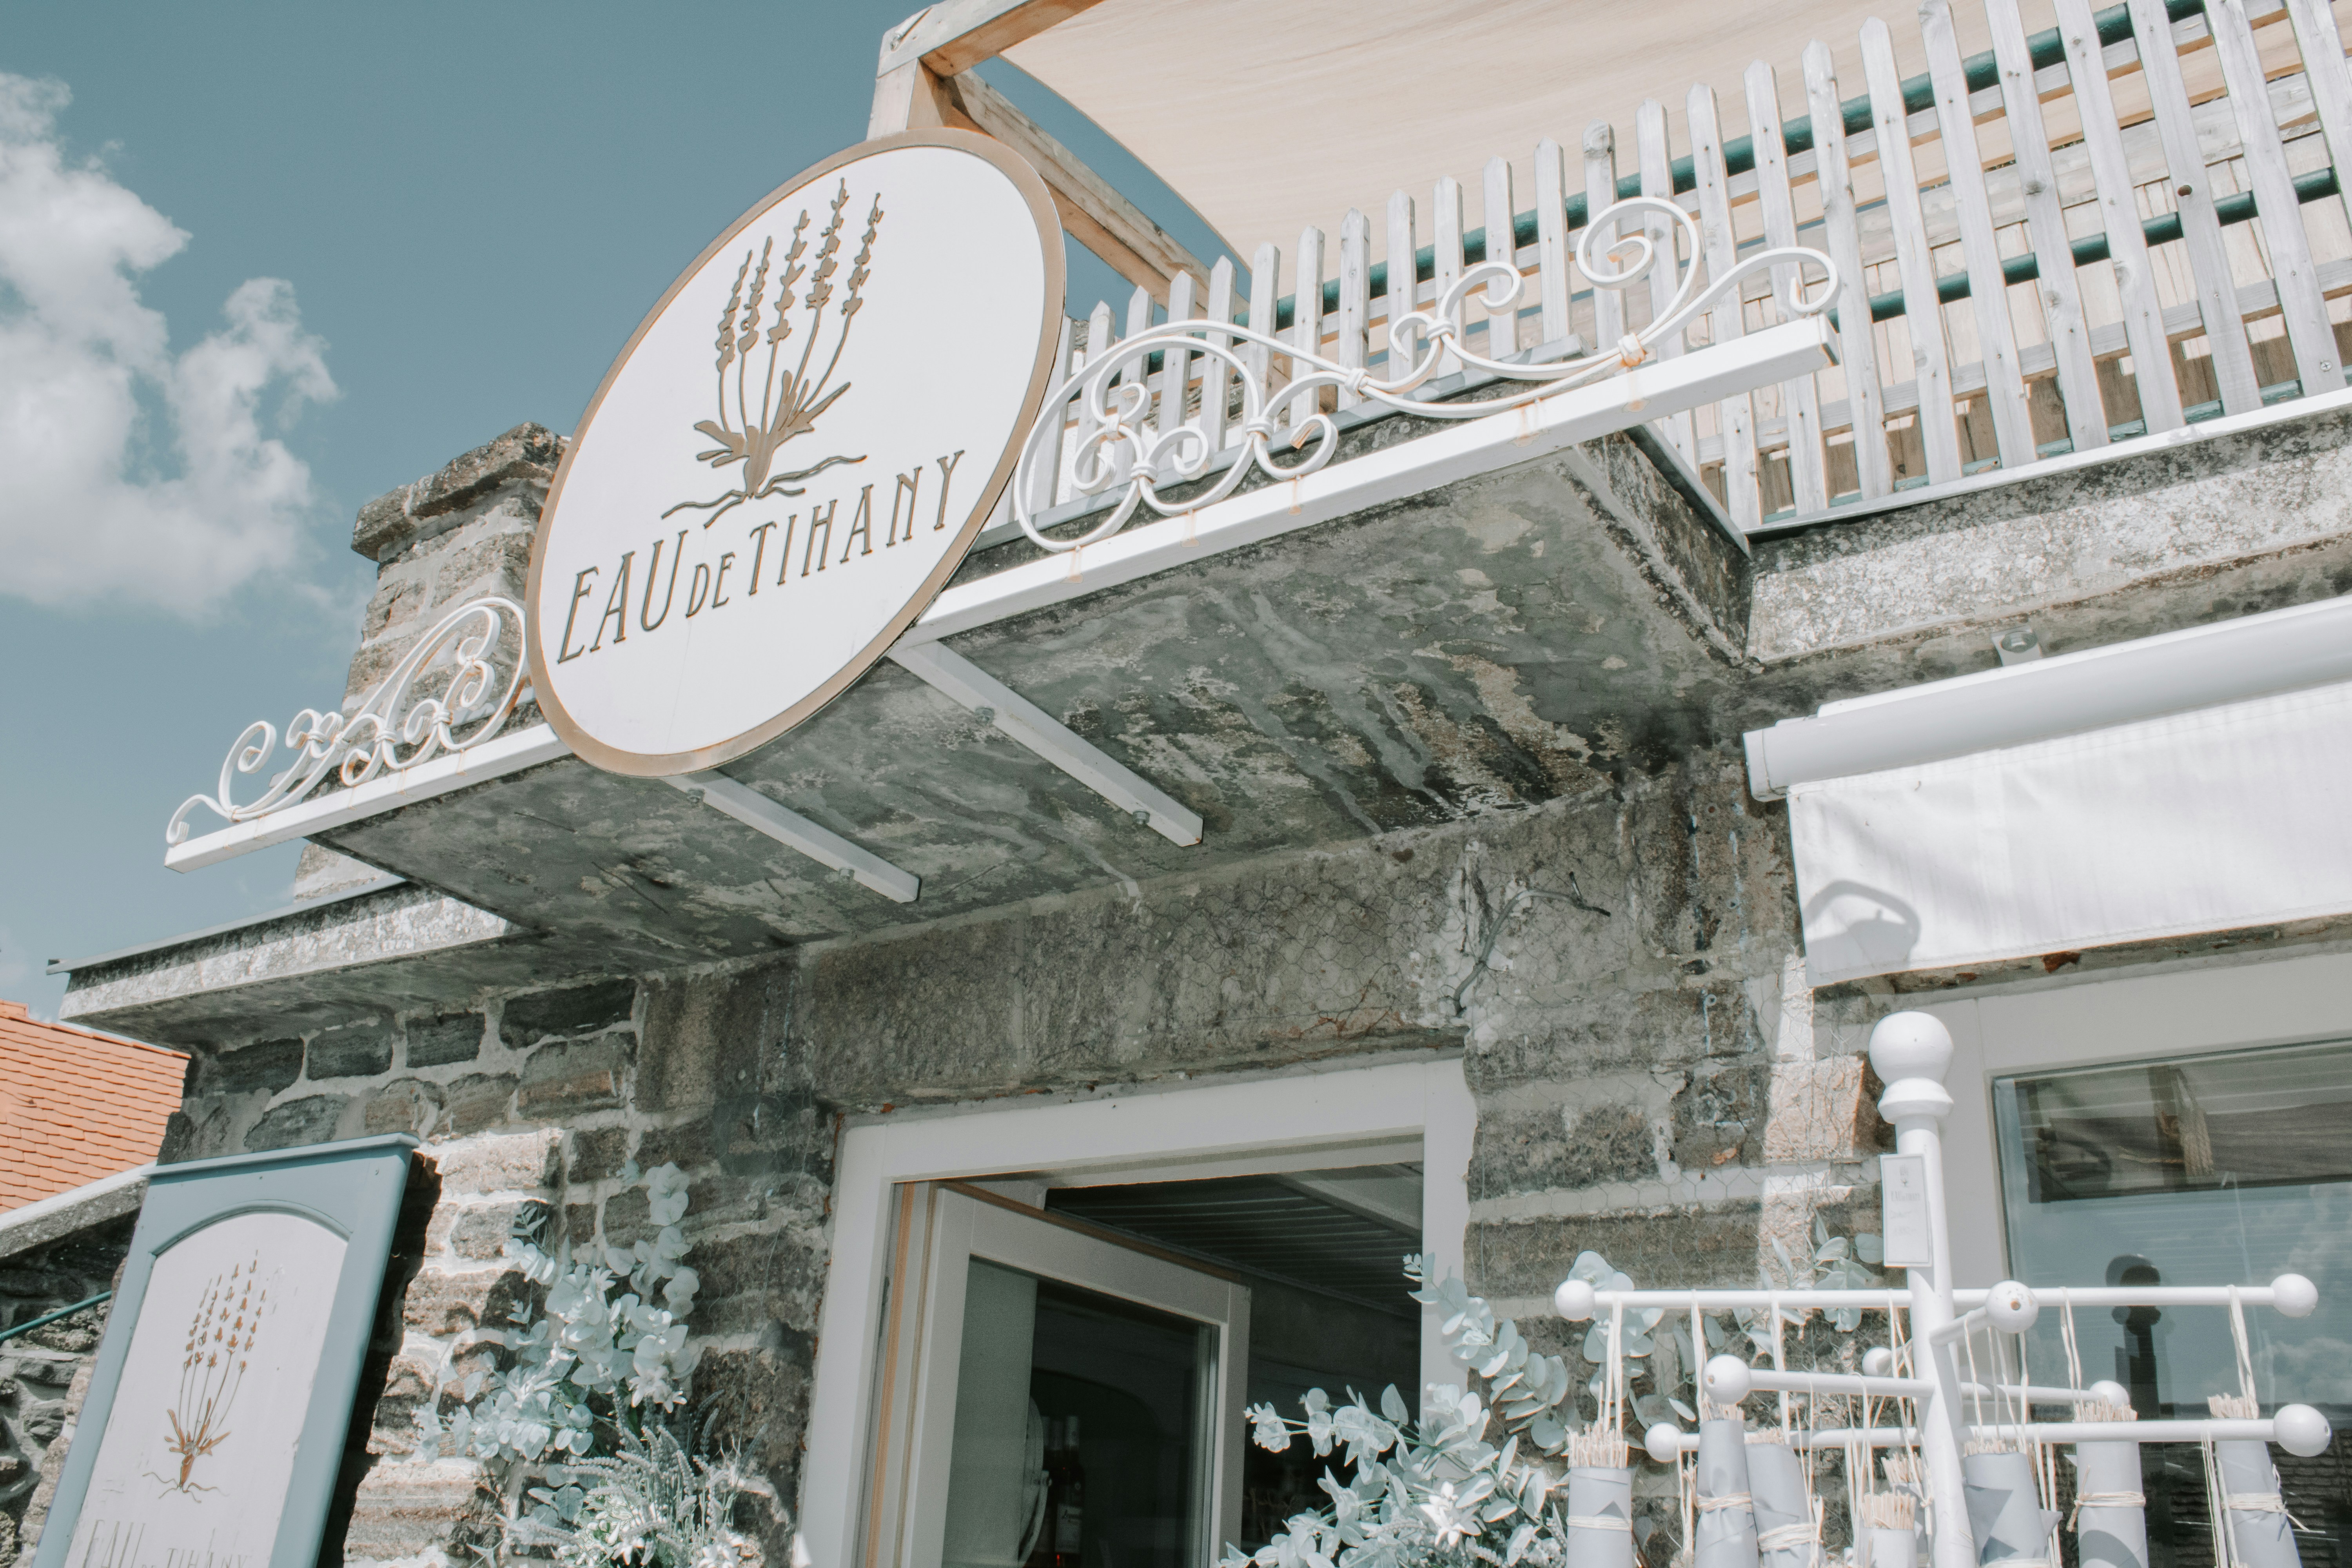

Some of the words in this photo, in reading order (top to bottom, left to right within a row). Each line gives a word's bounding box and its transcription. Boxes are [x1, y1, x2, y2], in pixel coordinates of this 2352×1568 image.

[556, 529, 689, 664] EAU
[685, 551, 736, 619] DE
[748, 450, 965, 596] TIHANY
